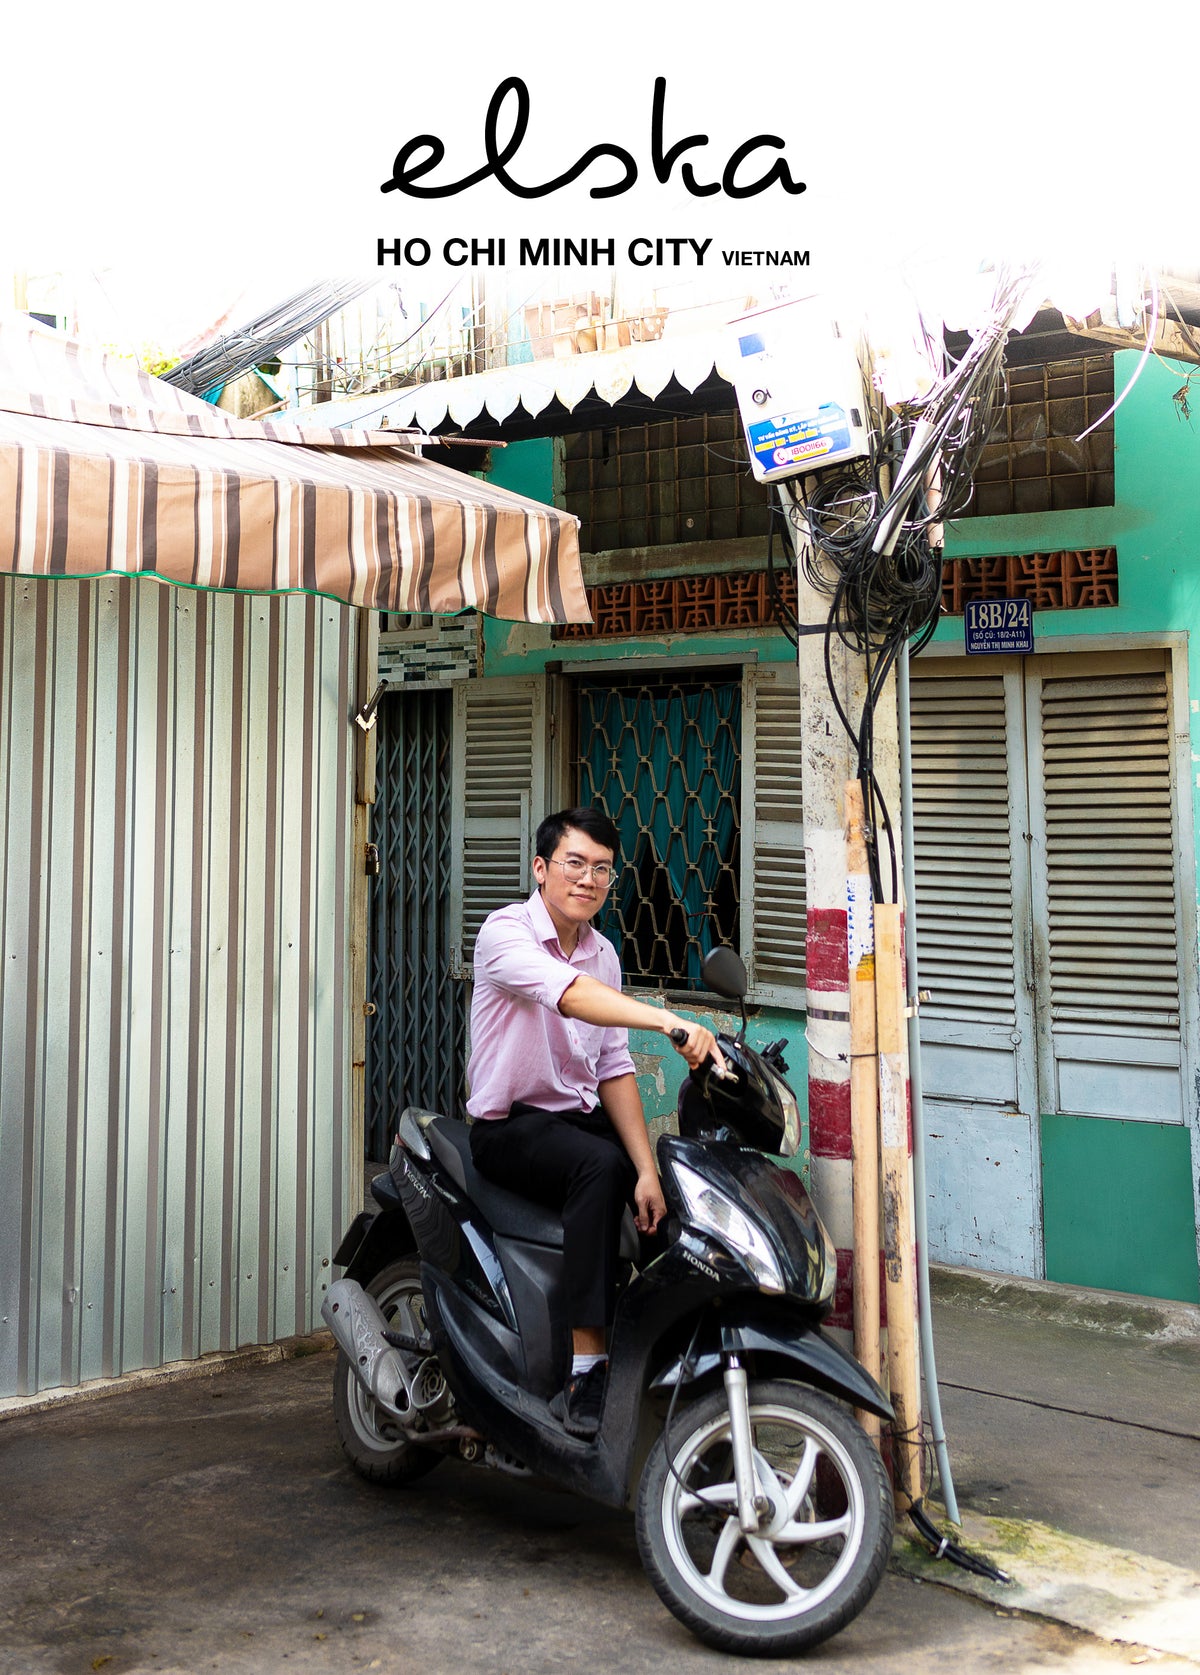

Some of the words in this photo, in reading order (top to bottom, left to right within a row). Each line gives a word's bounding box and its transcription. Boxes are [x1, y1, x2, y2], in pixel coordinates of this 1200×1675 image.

[969, 602, 1029, 629] 18B/24
[973, 630, 984, 640] (SỐ
[997, 630, 1025, 639] 18/2-A11)
[970, 640, 991, 650] NGUYỄN
[991, 642, 1001, 650] THỊ
[1001, 641, 1015, 649] MINH
[1015, 640, 1029, 648] KHAI
[682, 1249, 721, 1283] HONDA
